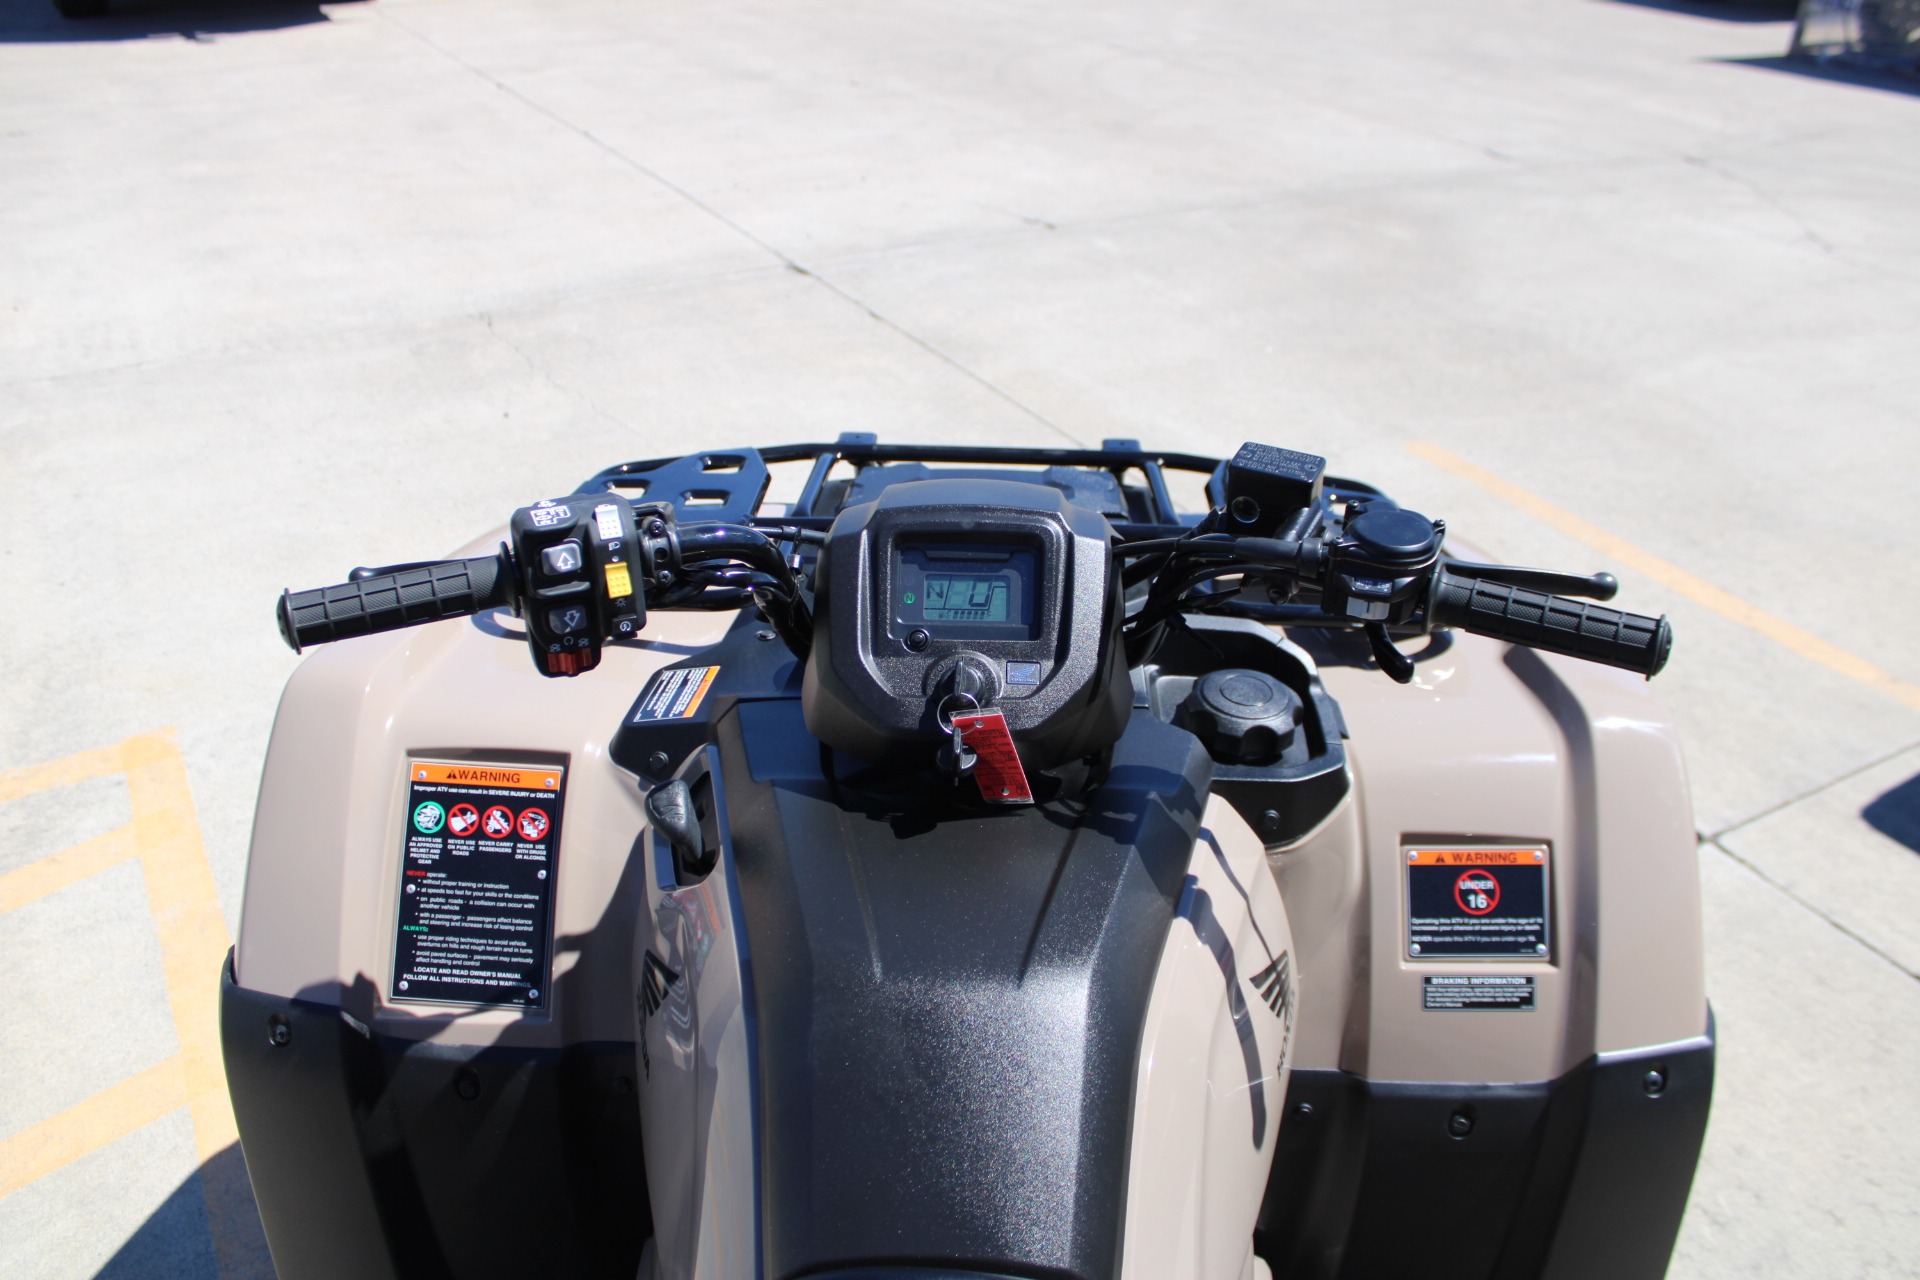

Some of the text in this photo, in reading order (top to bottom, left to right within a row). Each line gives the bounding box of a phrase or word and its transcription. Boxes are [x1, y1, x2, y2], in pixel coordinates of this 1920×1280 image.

[926, 581, 944, 599] N
[458, 770, 520, 784] WARNING
[1452, 852, 1518, 864] WARNING
[1459, 880, 1494, 890] UNDER
[1467, 894, 1488, 908] 16
[441, 976, 484, 985] INSTRUCTIONS
[1431, 977, 1526, 985] BRAKING INFORMATION
